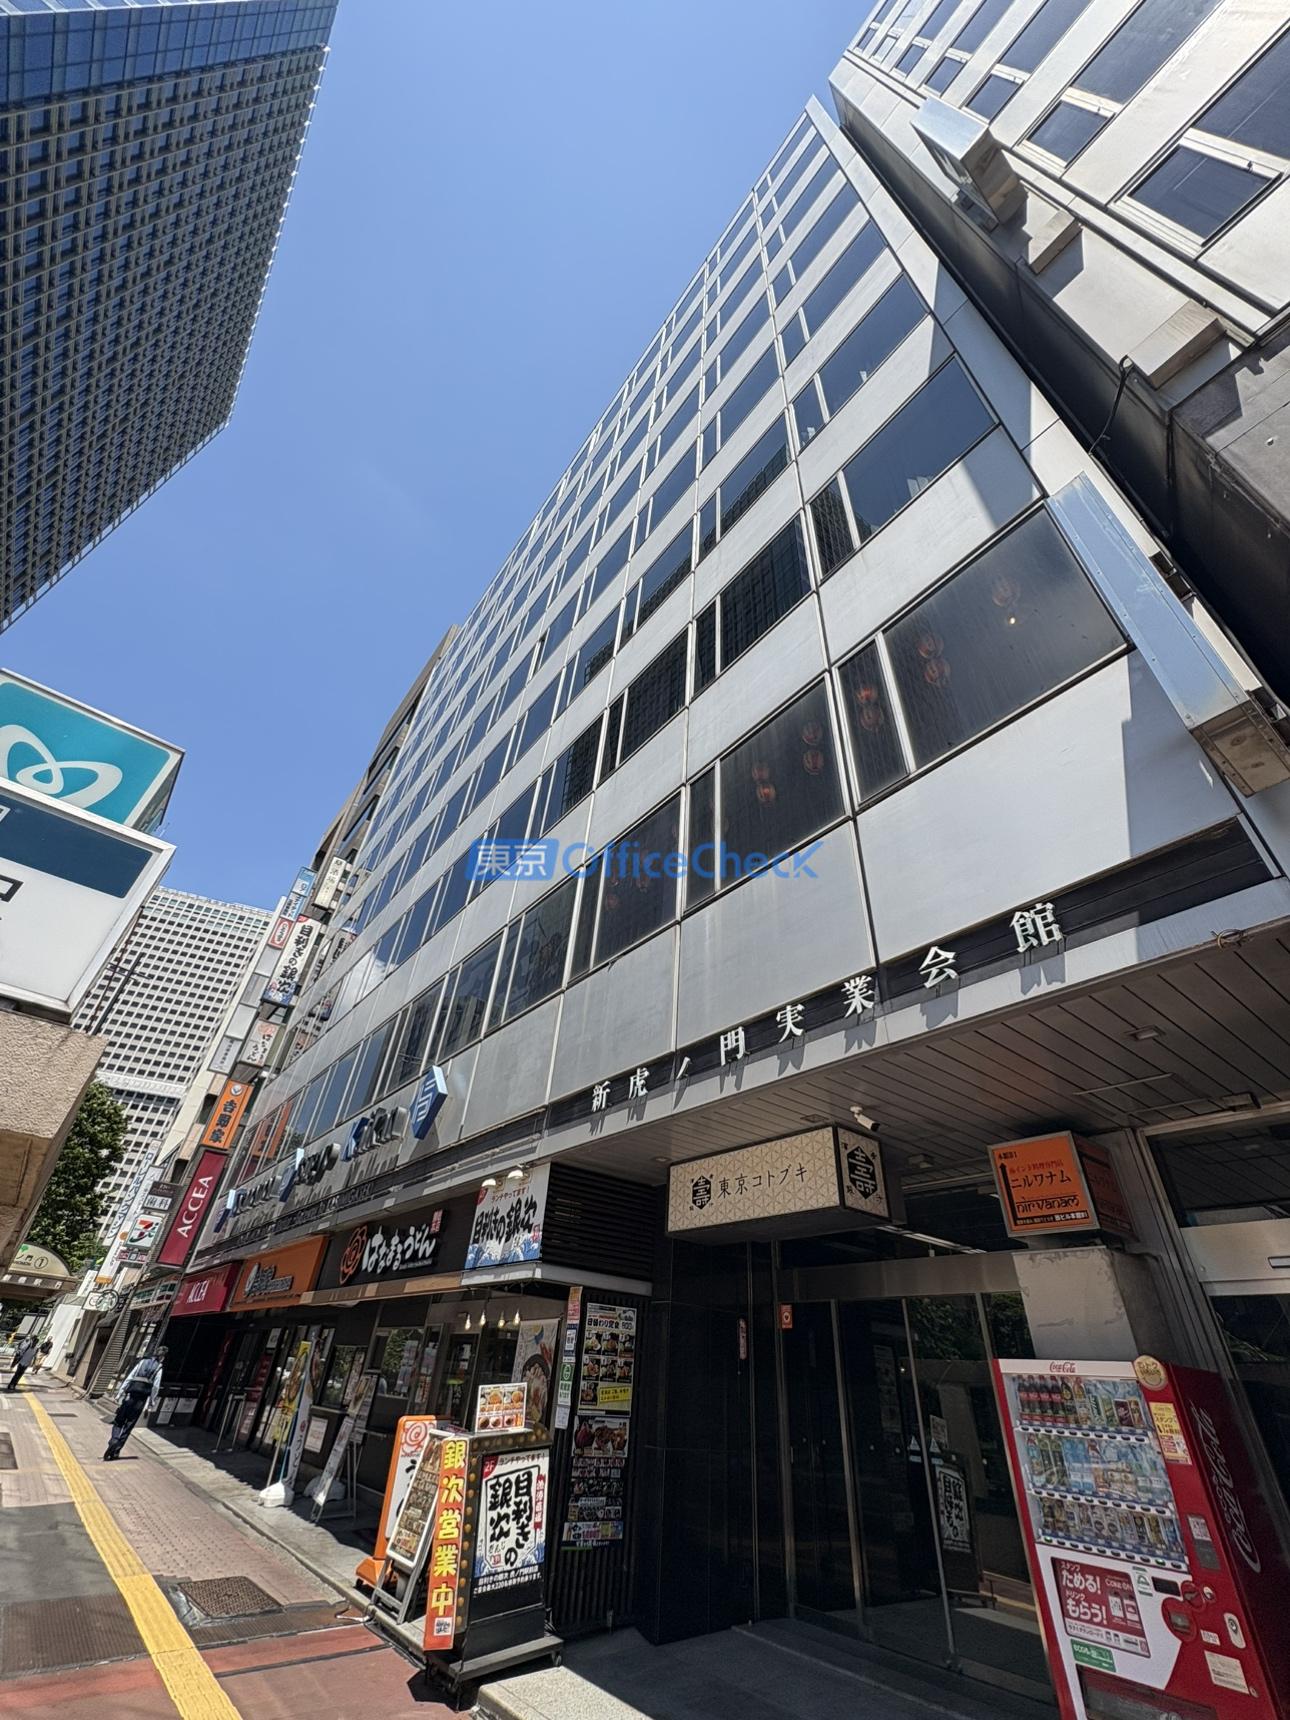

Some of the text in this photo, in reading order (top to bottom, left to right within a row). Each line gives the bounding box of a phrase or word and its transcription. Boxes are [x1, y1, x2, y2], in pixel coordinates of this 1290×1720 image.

[592, 902, 1064, 1112] 新虎ノ門実業会館
[717, 1162, 807, 1199] 東京コトブキ
[1011, 1169, 1071, 1188] ニルワナム
[176, 1176, 213, 1238] ACCEA
[361, 1225, 436, 1274] はなまるうどん
[1049, 1361, 1077, 1374] Coca-Cola
[484, 1461, 495, 1473] 2F
[488, 1477, 513, 1543] 銀次
[430, 1439, 467, 1617] 銀次営業中
[1062, 1569, 1102, 1595] ためる！
[1066, 1589, 1086, 1601] ドリンク
[1066, 1598, 1108, 1625] もらう！
